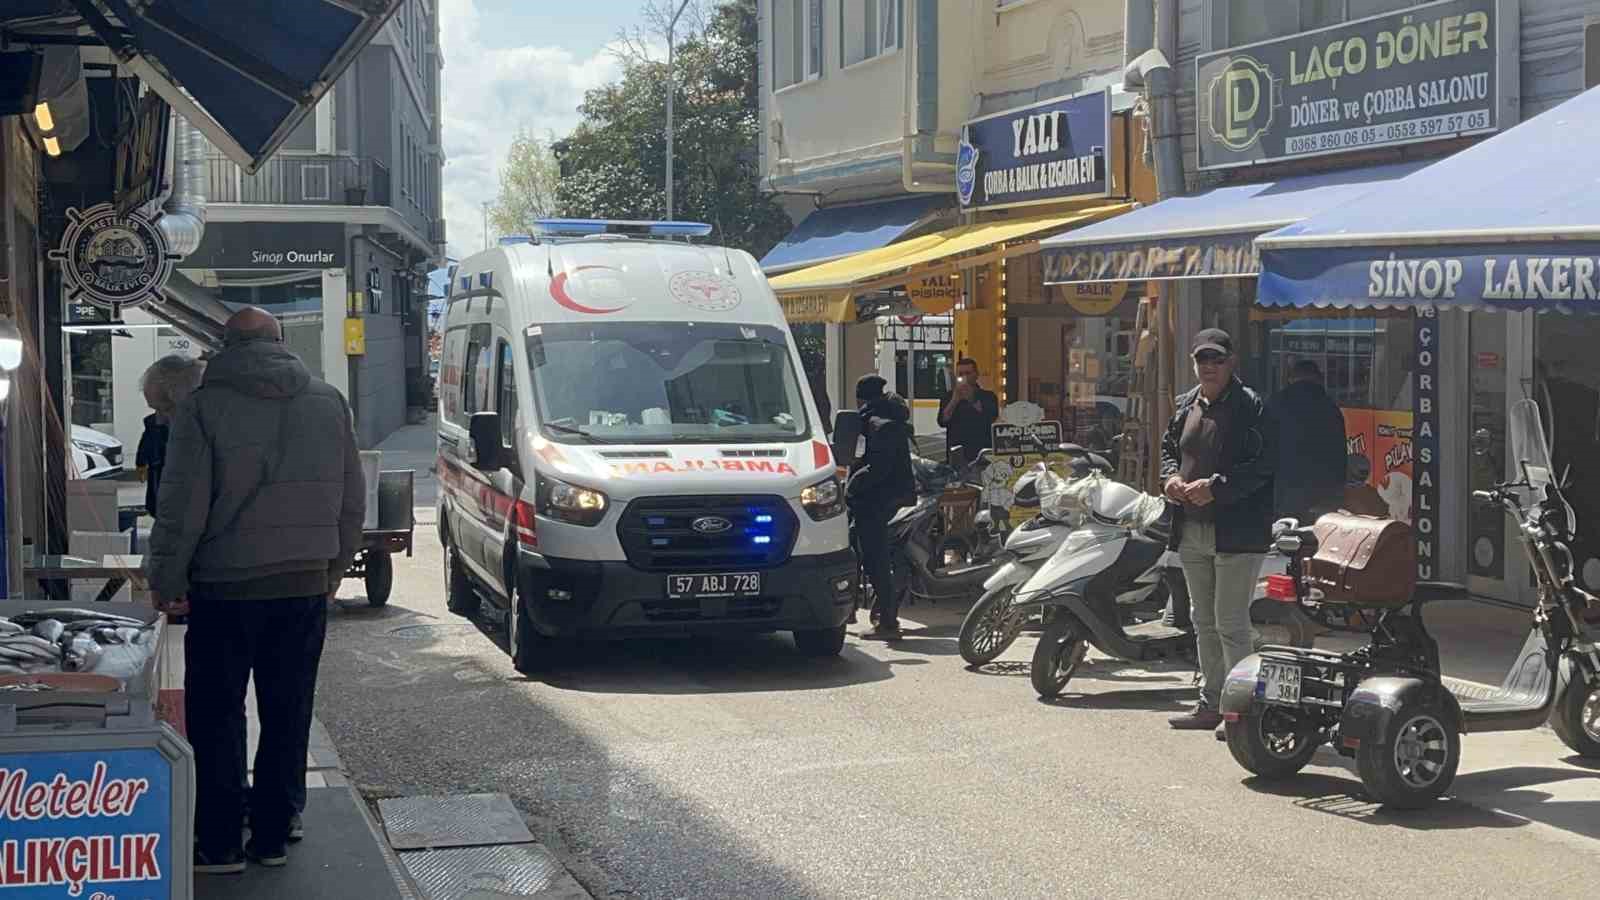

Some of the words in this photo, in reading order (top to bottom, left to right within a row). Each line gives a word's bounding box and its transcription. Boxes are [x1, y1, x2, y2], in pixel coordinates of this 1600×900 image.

[1290, 37, 1367, 90] LAÇO
[1376, 11, 1489, 69] DÖNER
[1290, 97, 1340, 128] DÖNER
[1343, 102, 1360, 121] ve
[1363, 86, 1415, 124] ÇORBA
[1418, 72, 1489, 108] SALONU
[1012, 110, 1060, 158] YALI
[1291, 137, 1318, 152] 0368
[1321, 132, 1341, 147] 260
[1343, 131, 1358, 144] 06
[1360, 129, 1376, 142] 05
[1387, 123, 1417, 139] 0552
[1420, 118, 1443, 134] 597
[1447, 115, 1465, 130] 57
[1468, 111, 1485, 127] 05
[984, 169, 1008, 201] ÇORBA
[1009, 168, 1016, 192] &
[1016, 164, 1040, 192] BALIK
[1040, 163, 1047, 188] &
[1048, 158, 1079, 188] IZGARA
[252, 250, 284, 266] Sinop
[287, 250, 334, 263] Onurlar
[1368, 252, 1463, 299] SİNOP
[1483, 257, 1600, 300] LAKER
[1419, 327, 1432, 438] ÇORBA
[1418, 447, 1432, 580] SALONU
[676, 577, 693, 593] 57
[701, 576, 727, 592] ABJ
[733, 574, 758, 591] 728
[0, 833, 161, 896] LIKÇILIK
